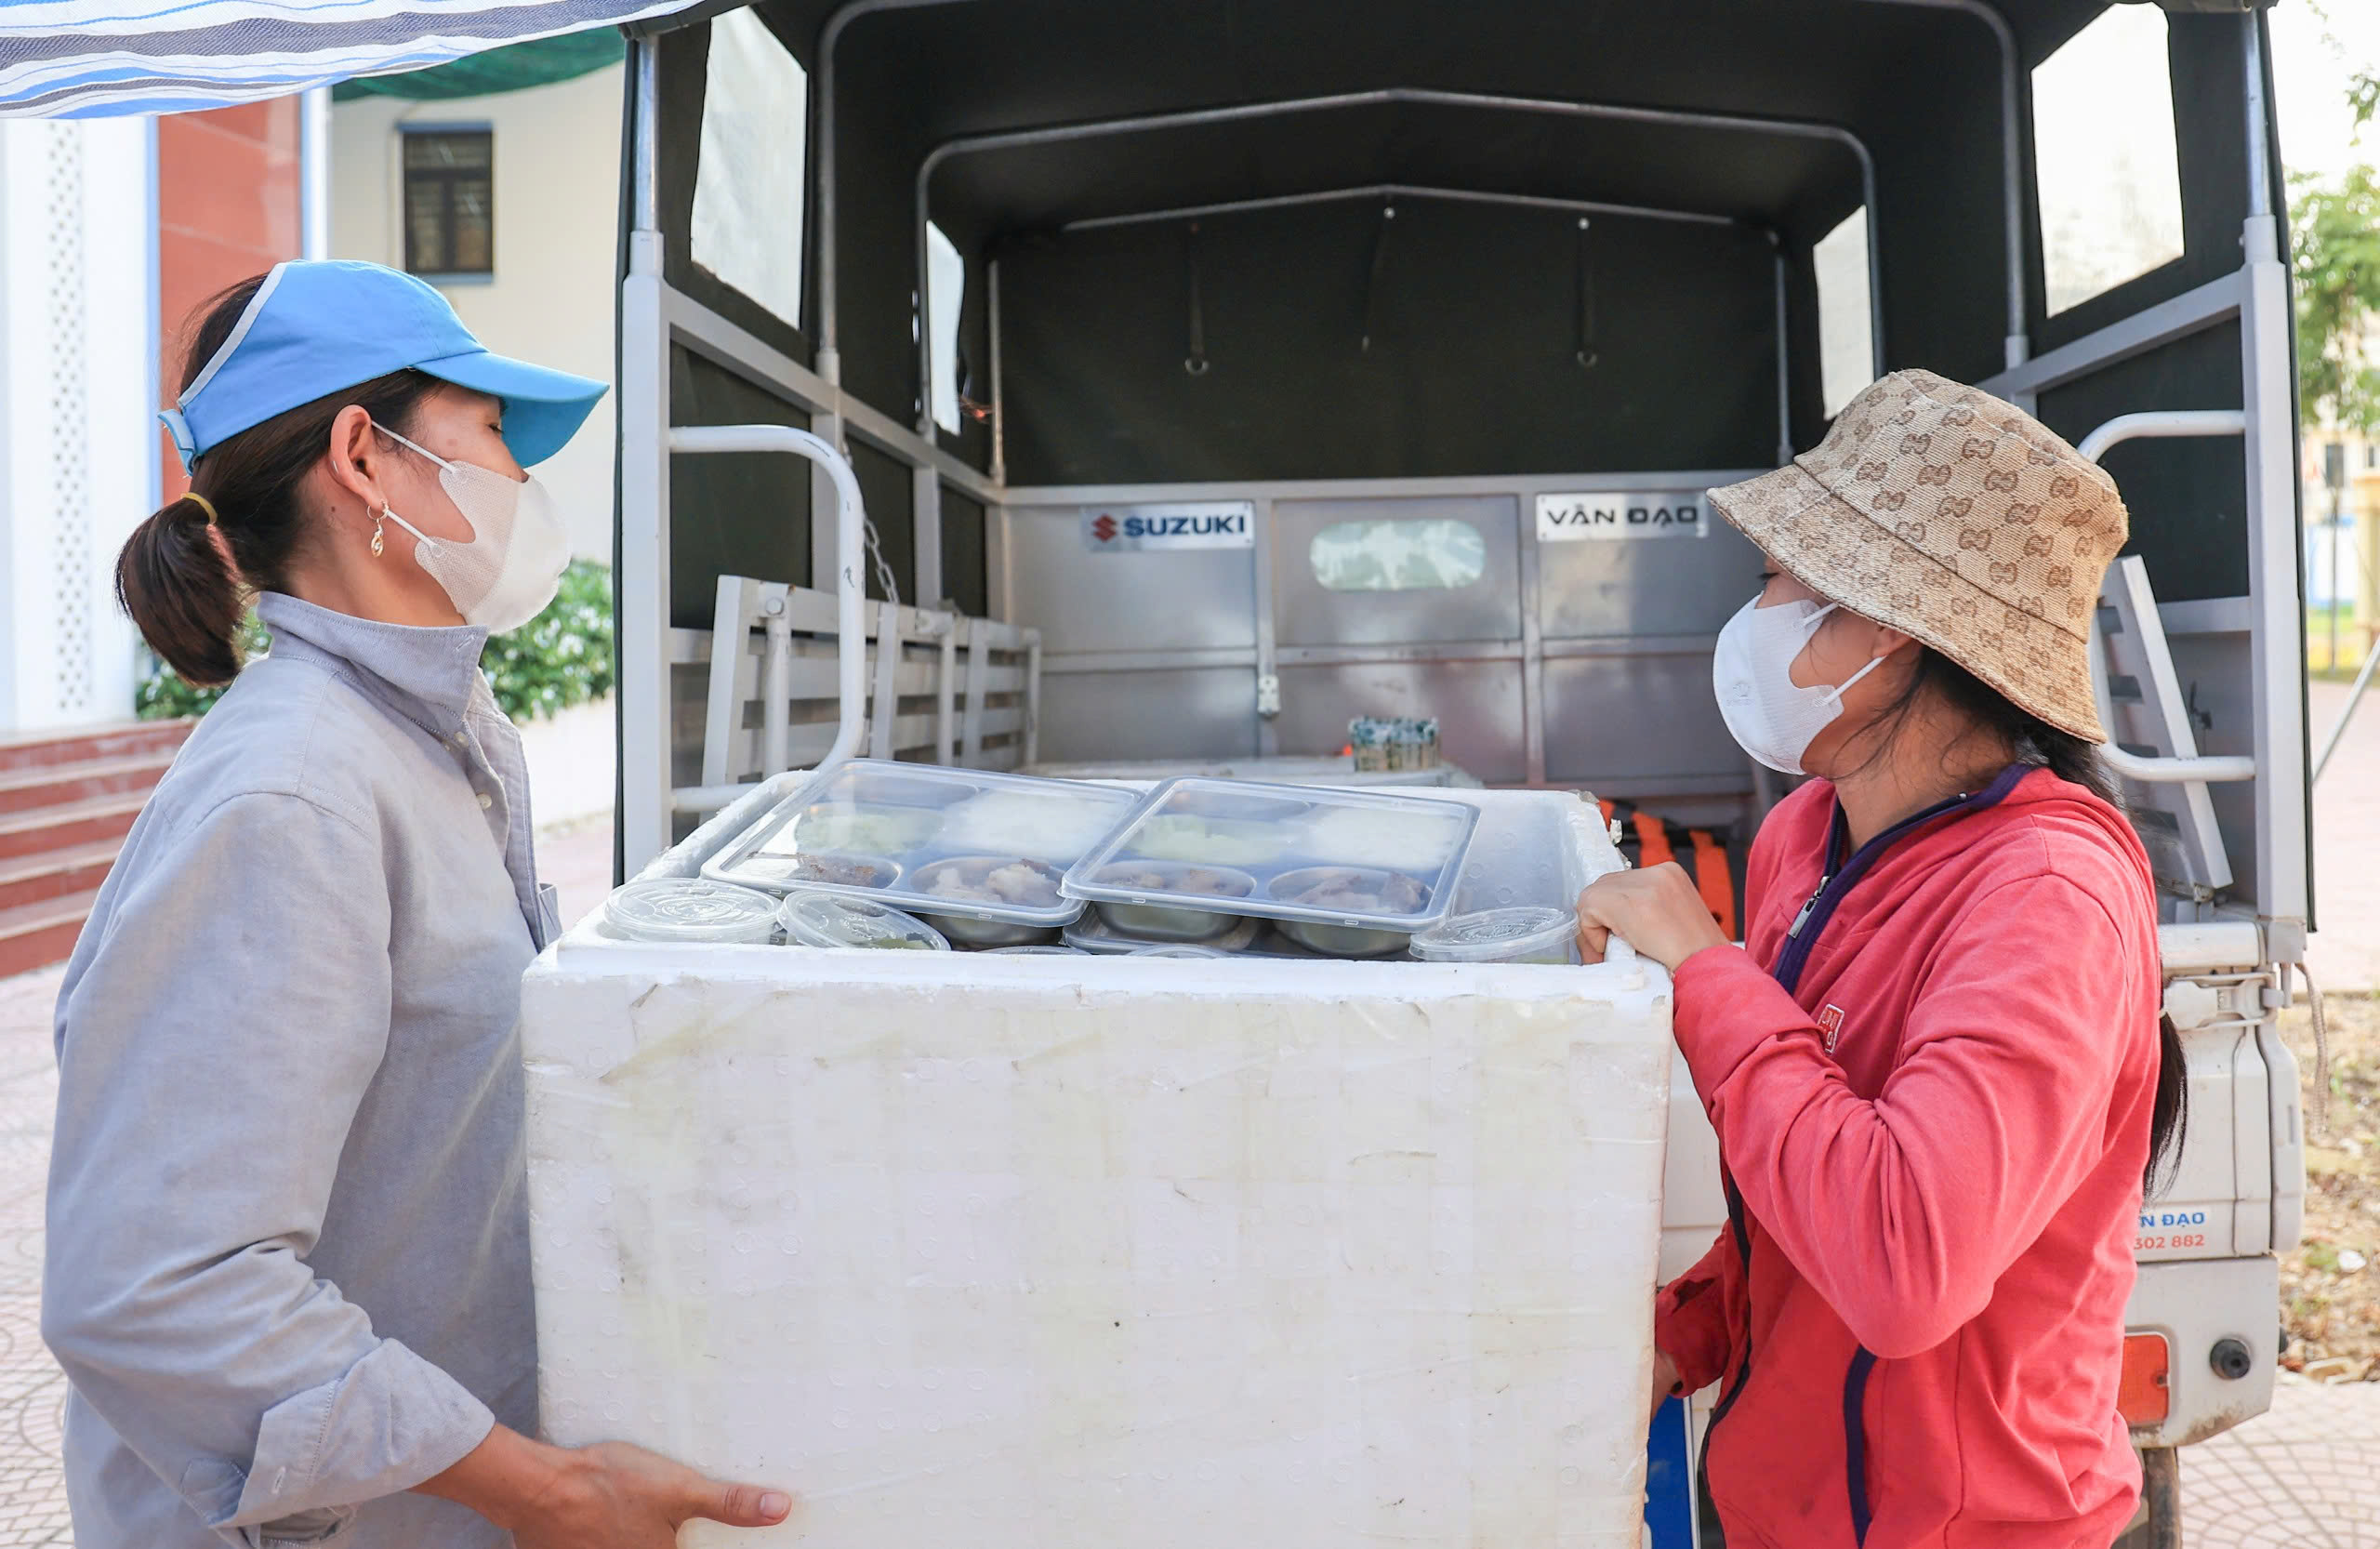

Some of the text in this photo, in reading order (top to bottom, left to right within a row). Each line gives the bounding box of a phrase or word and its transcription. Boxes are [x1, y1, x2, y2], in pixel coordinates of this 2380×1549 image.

[1123, 515, 1245, 538] SUZUKI
[2140, 1212, 2205, 1227] N ĐẠO
[2172, 1235, 2204, 1248] 882
